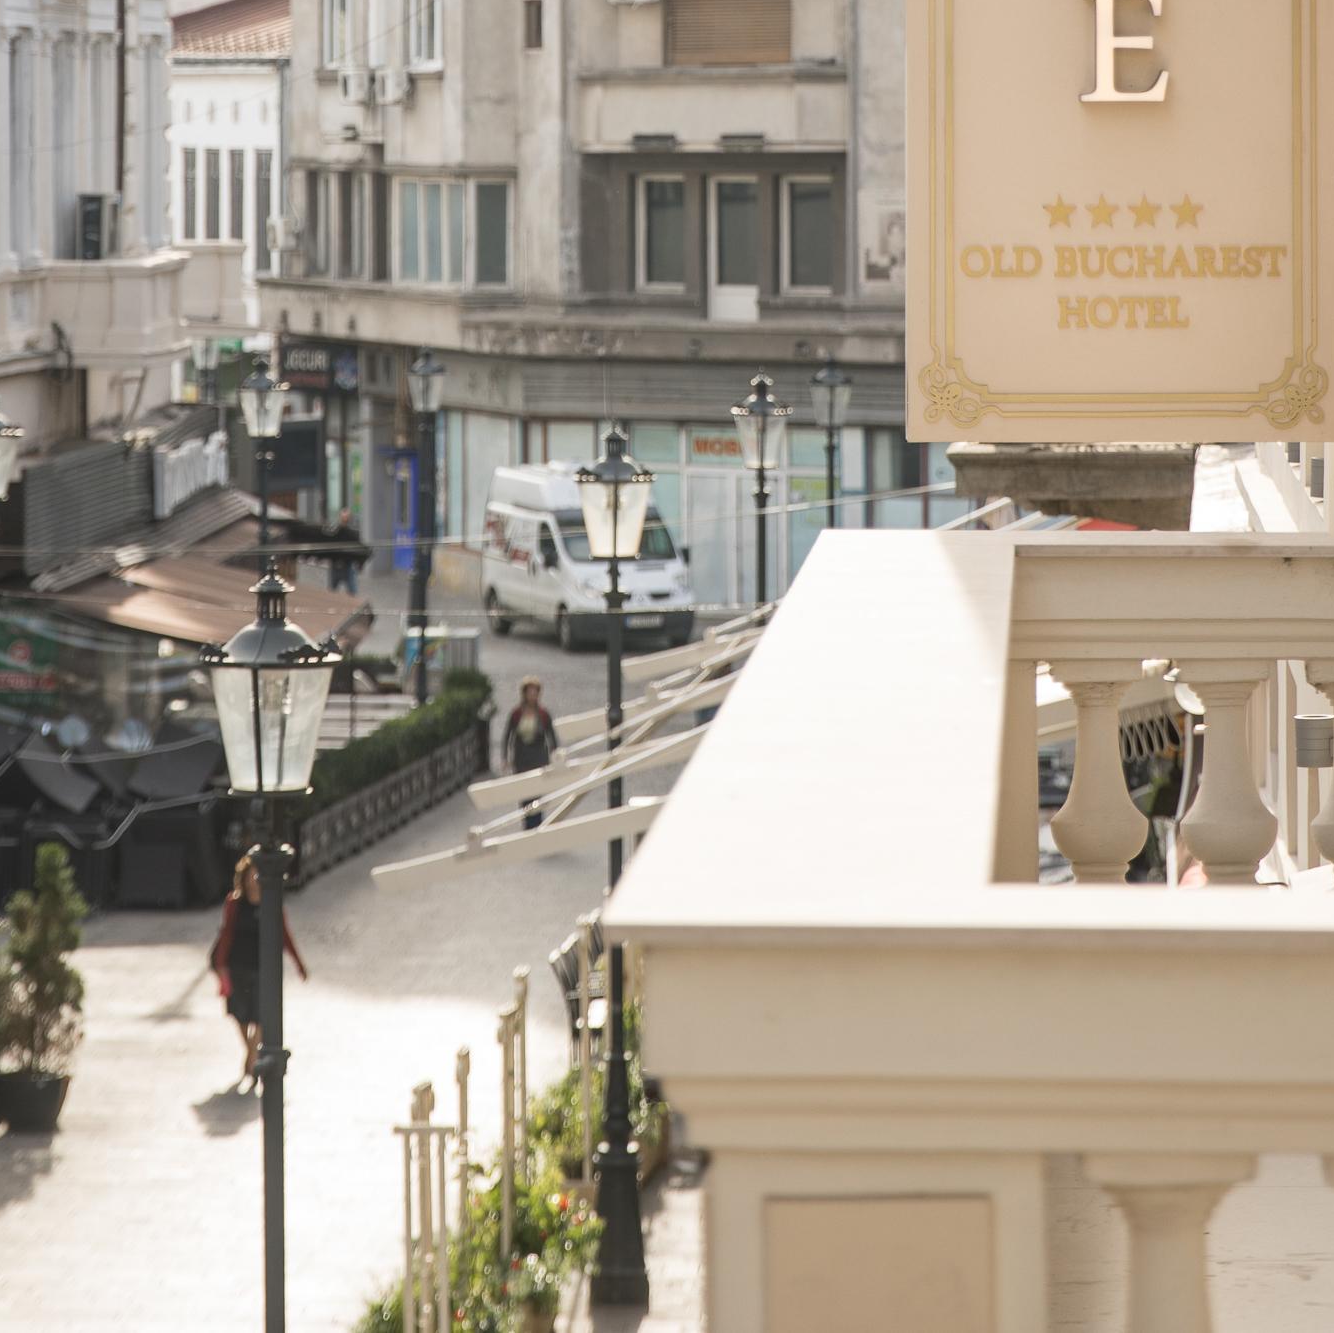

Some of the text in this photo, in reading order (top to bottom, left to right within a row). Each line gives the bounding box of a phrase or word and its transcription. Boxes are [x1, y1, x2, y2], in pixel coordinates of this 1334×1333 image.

[959, 244, 1288, 280] OLD BUCHAREST
[1057, 295, 1190, 330] HOTEL
